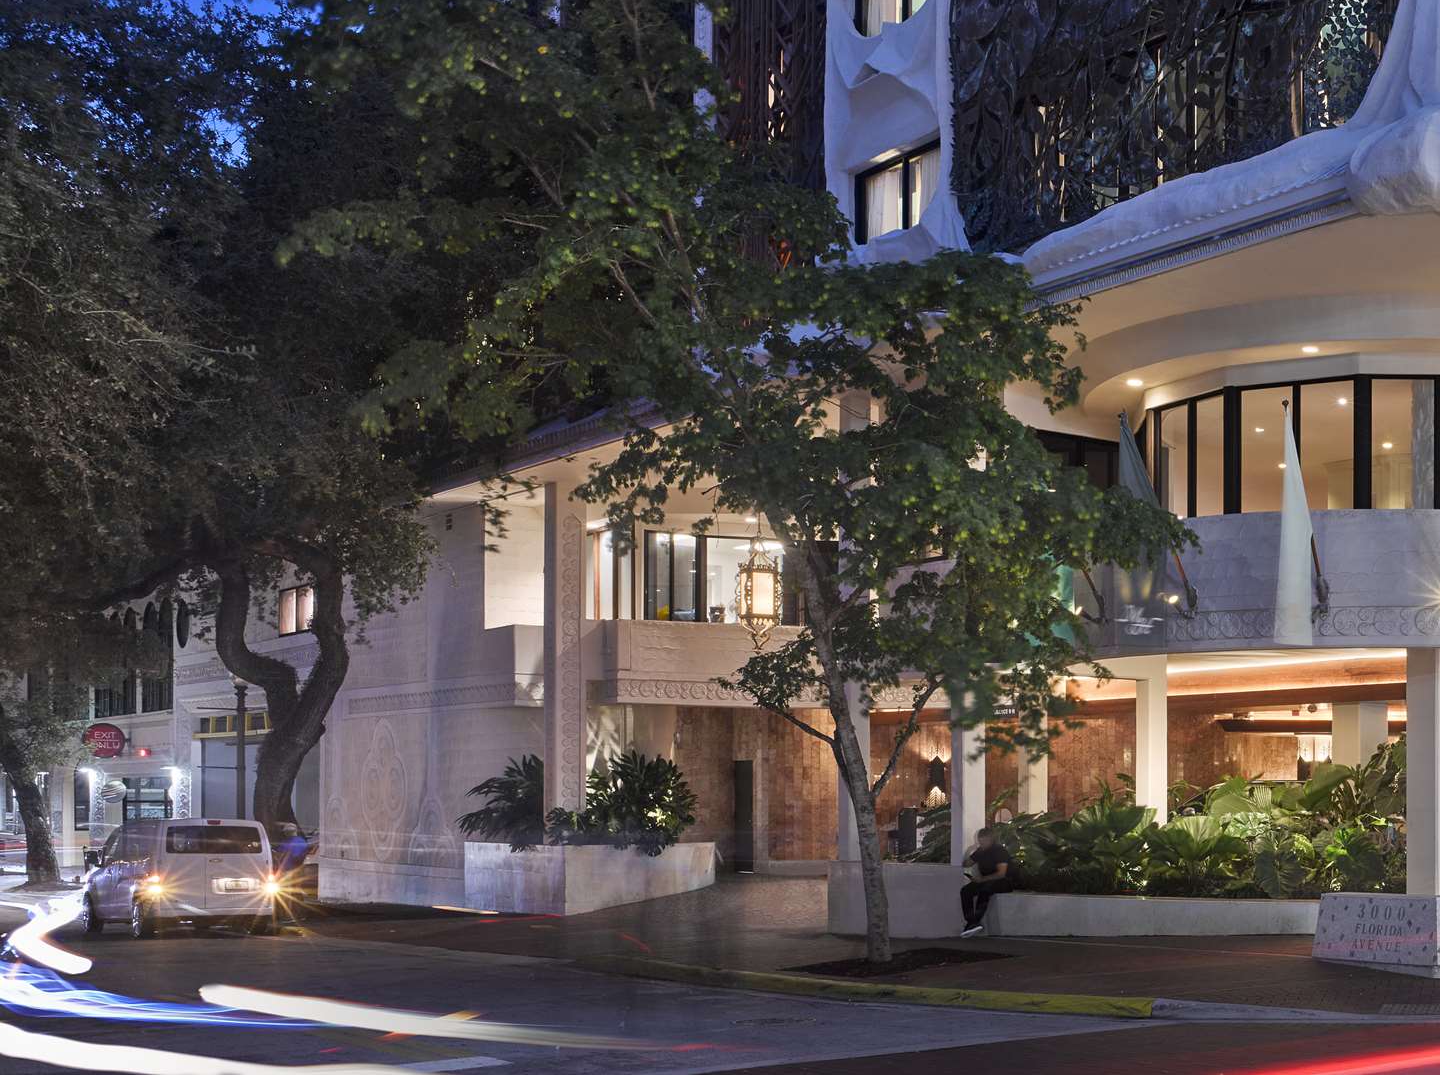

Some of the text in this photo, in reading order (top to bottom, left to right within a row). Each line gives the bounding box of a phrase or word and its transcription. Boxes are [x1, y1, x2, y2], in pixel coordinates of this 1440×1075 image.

[94, 731, 115, 739] EXIT
[1358, 904, 1405, 920] 3000
[1355, 923, 1402, 936] FLORIDA
[1352, 938, 1401, 952] AVENUE
